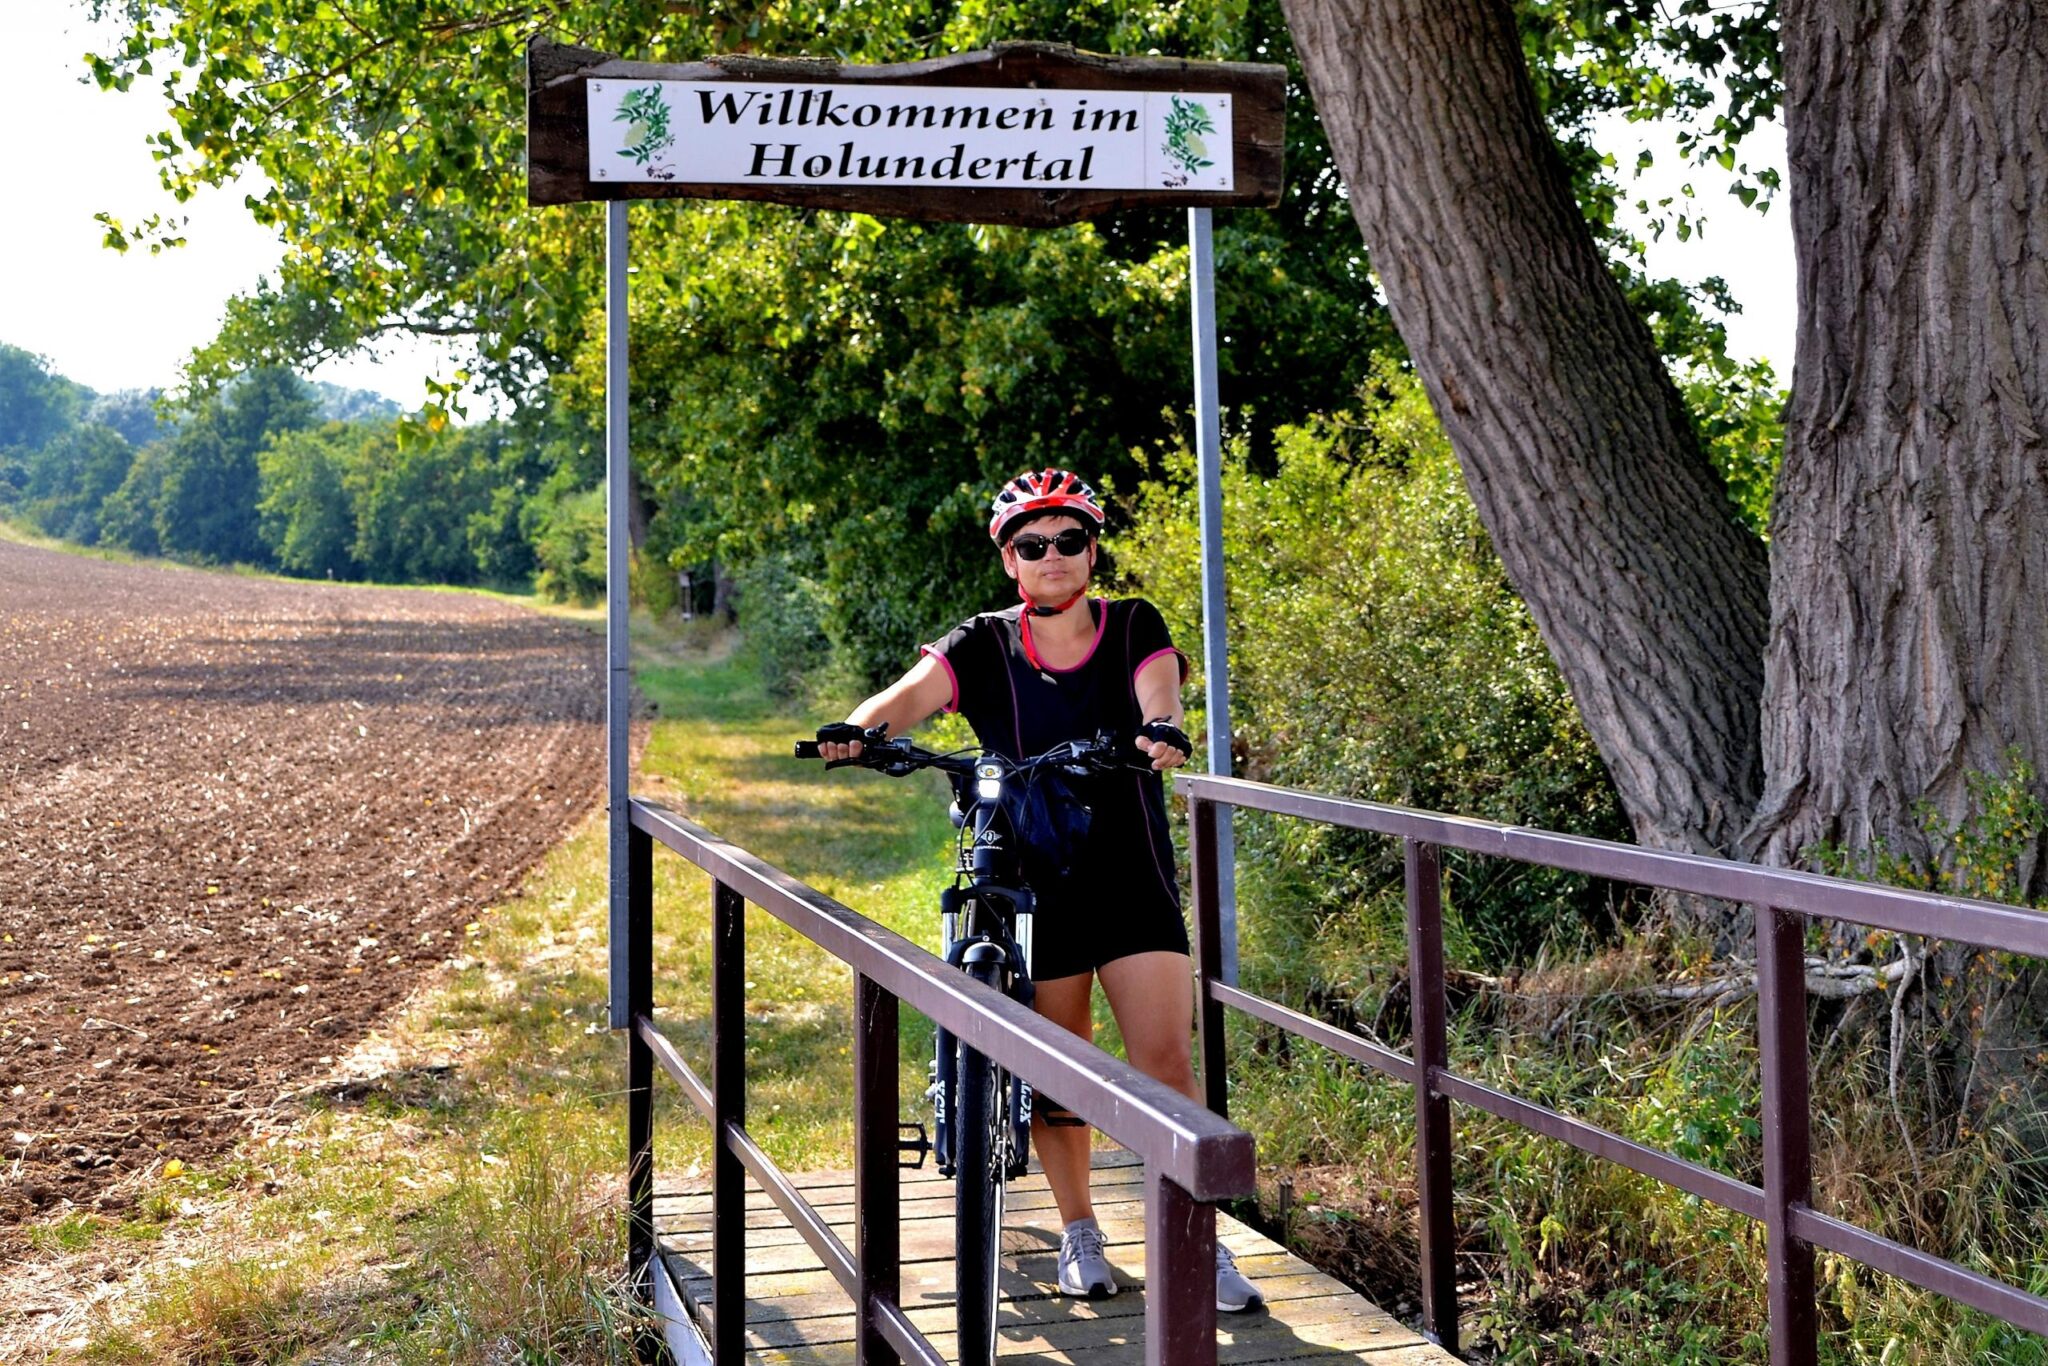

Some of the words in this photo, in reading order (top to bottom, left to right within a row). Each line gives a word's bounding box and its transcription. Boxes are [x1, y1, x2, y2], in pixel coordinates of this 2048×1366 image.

[694, 89, 1055, 131] Willkommen
[1072, 99, 1140, 132] im
[743, 141, 1095, 181] Holundertal
